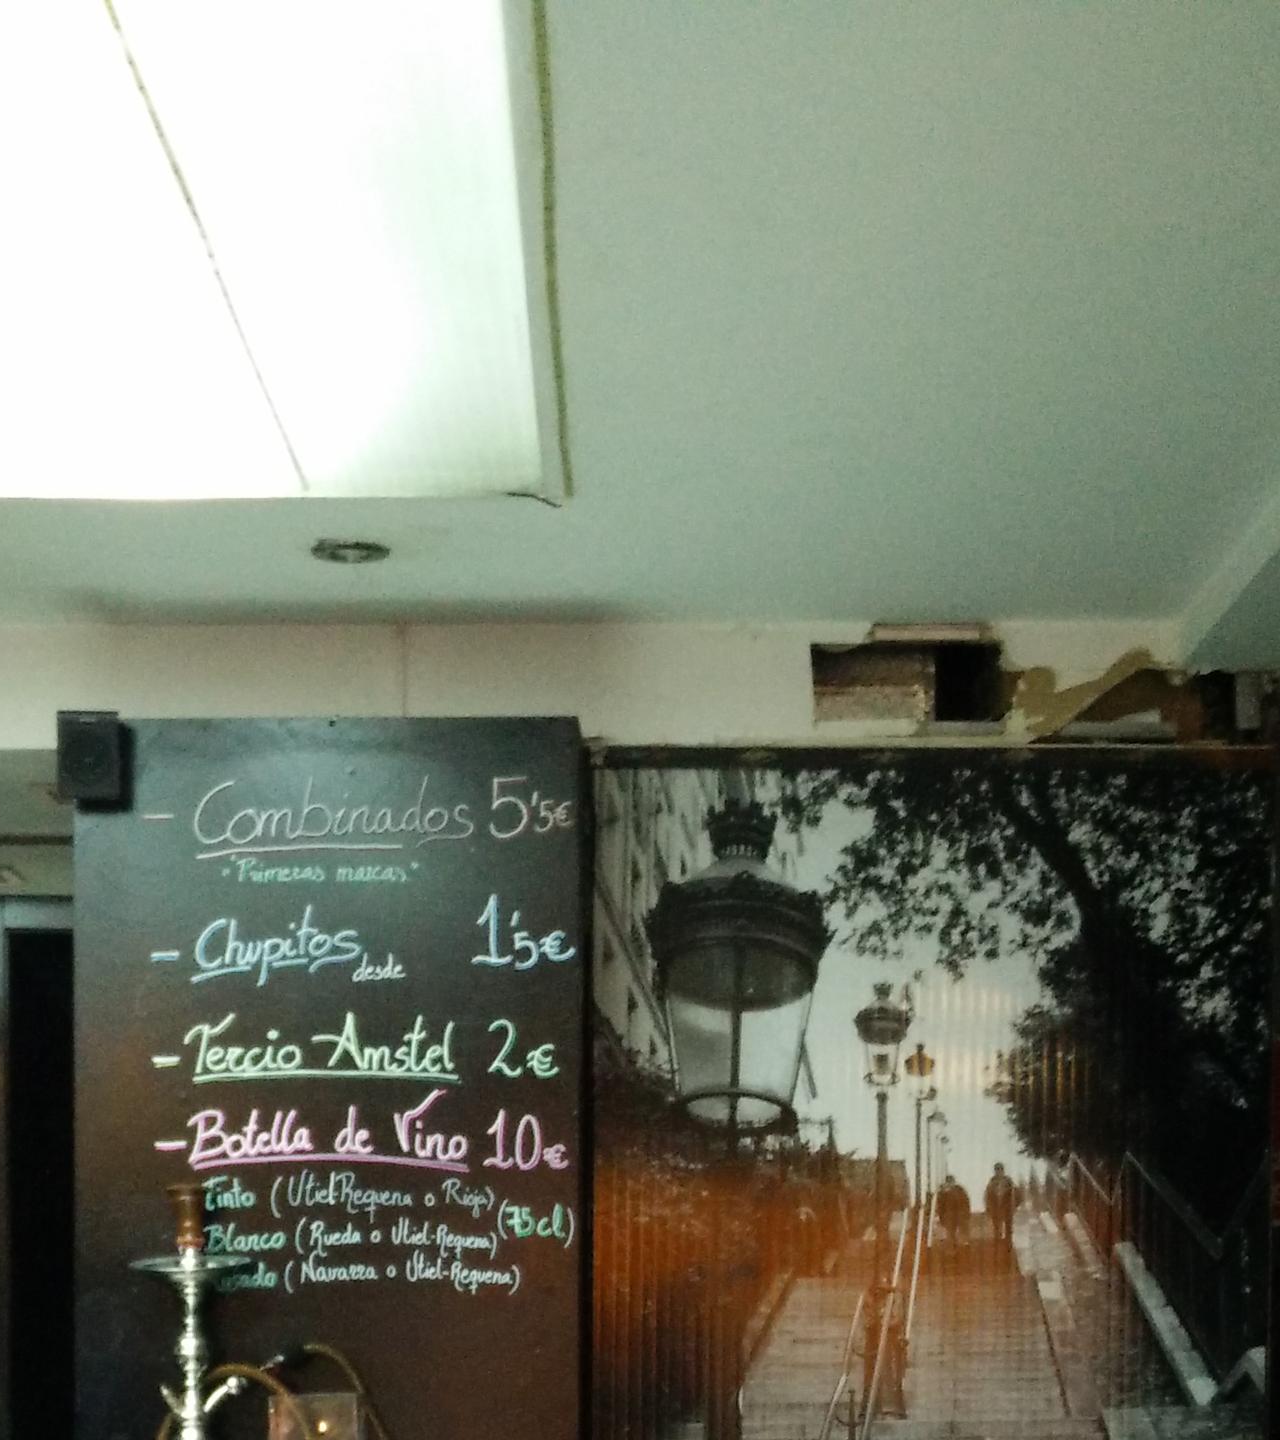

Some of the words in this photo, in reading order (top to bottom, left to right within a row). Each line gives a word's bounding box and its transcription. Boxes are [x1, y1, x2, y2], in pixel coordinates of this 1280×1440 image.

[194, 776, 474, 847] Combinados
[194, 905, 363, 987] Chupitos
[352, 953, 406, 984] desde
[184, 1013, 302, 1075] Tercio
[312, 1011, 458, 1075] Amstel
[488, 1019, 561, 1080] 2€
[186, 1108, 314, 1164] Botella
[334, 1104, 374, 1155] de
[393, 1089, 470, 1161] Vino
[483, 1109, 569, 1171] 10€
[202, 1175, 257, 1211] Tinto
[424, 1193, 436, 1207] o
[203, 1222, 287, 1253] Blanco
[370, 1229, 382, 1243] o
[386, 1264, 397, 1278] o
